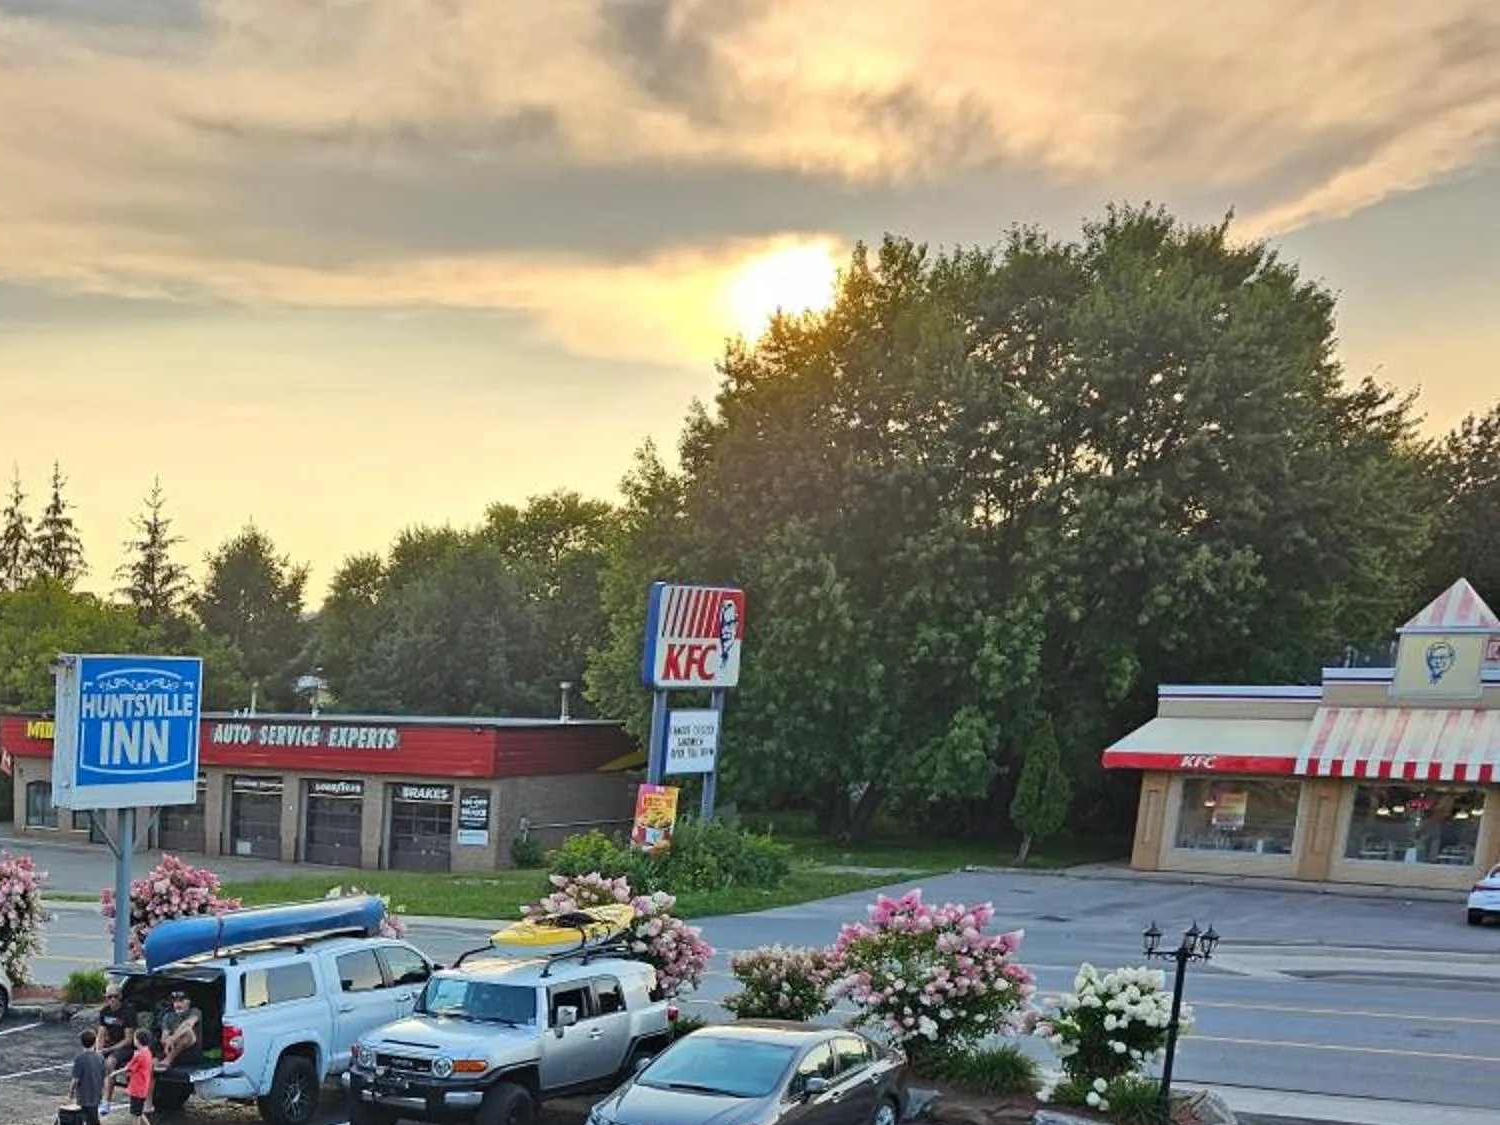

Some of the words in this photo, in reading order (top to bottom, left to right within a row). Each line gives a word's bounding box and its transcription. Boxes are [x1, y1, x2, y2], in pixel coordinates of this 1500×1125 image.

[661, 644, 717, 681] KFC
[81, 693, 193, 719] HUNTSVILLE
[26, 721, 54, 738] MID
[213, 724, 251, 745] AUTO
[259, 726, 321, 747] SERVICE
[328, 727, 397, 749] EXPERTS
[100, 720, 169, 765] INN
[1179, 755, 1217, 769] KFC
[402, 786, 449, 800] BRAKES
